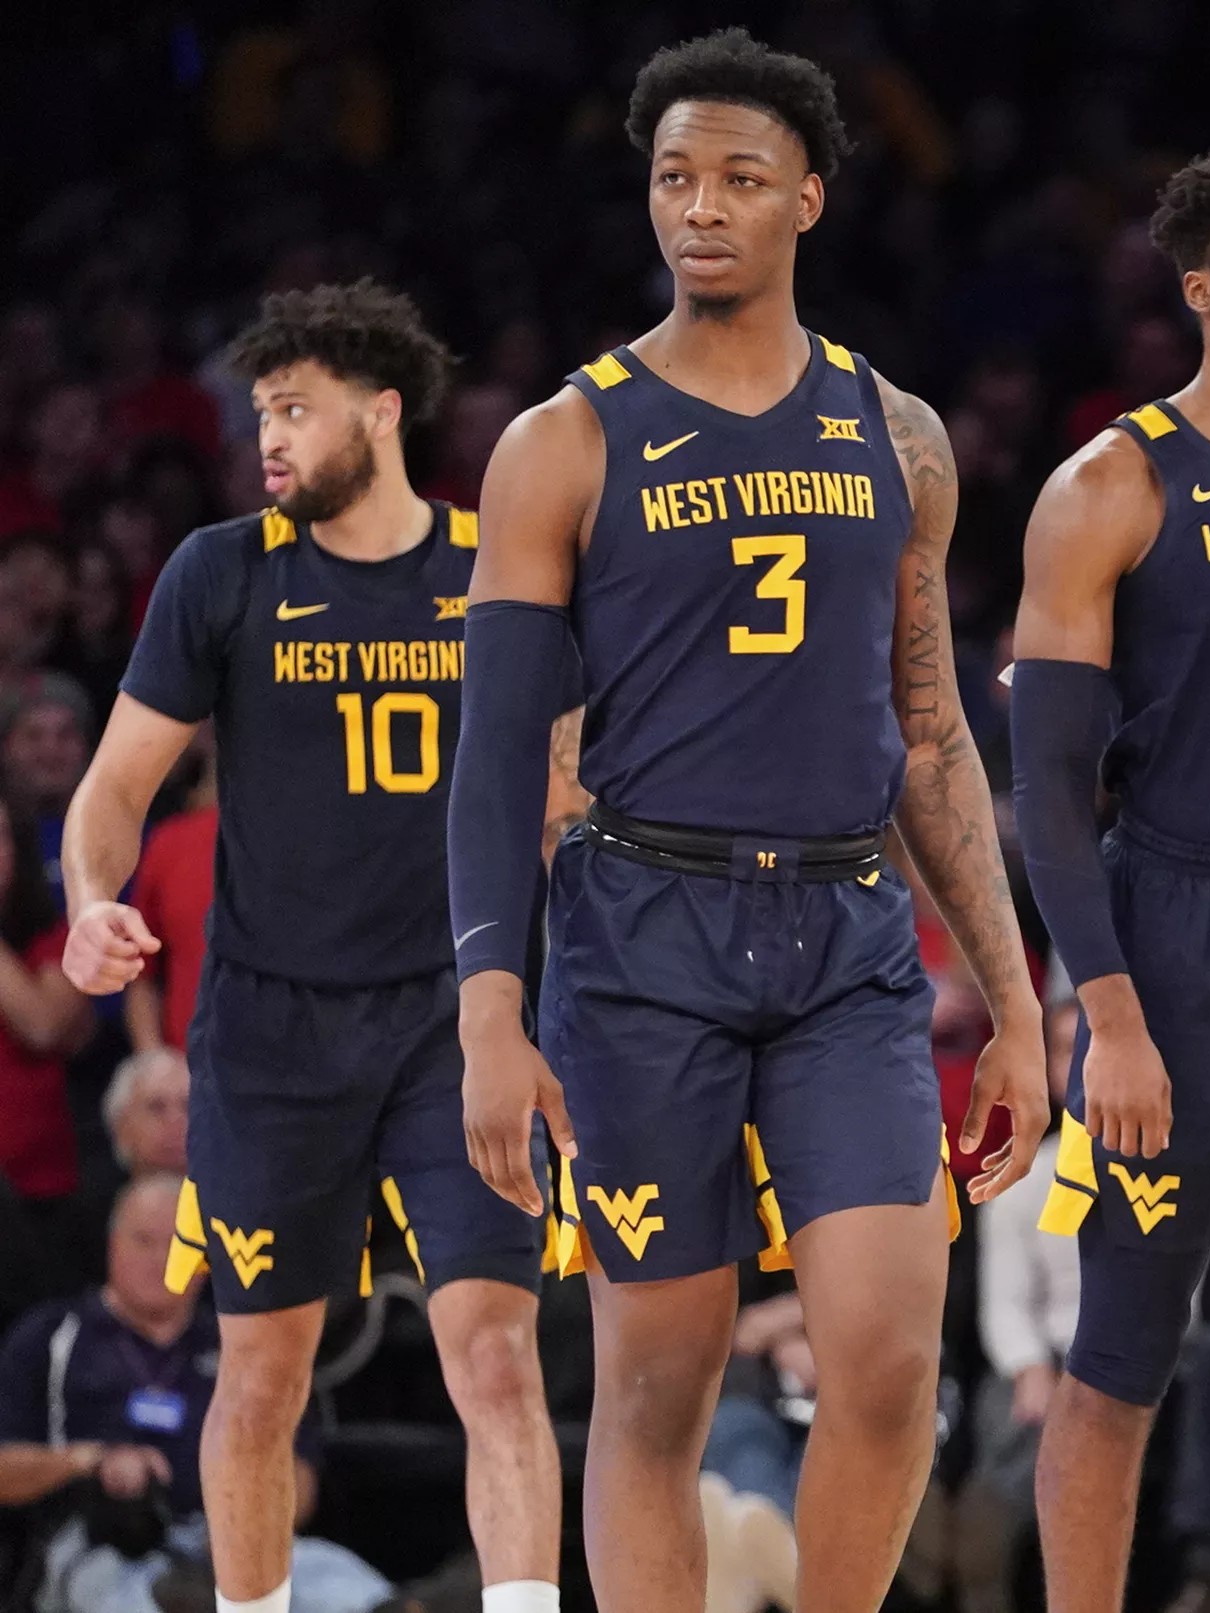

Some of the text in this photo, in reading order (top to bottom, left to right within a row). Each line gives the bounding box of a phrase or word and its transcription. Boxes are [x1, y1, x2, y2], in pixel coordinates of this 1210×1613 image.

[641, 471, 876, 533] WEST VIRGINIA
[728, 534, 807, 655] 3
[274, 640, 351, 683] WEST
[335, 691, 440, 795] 10
